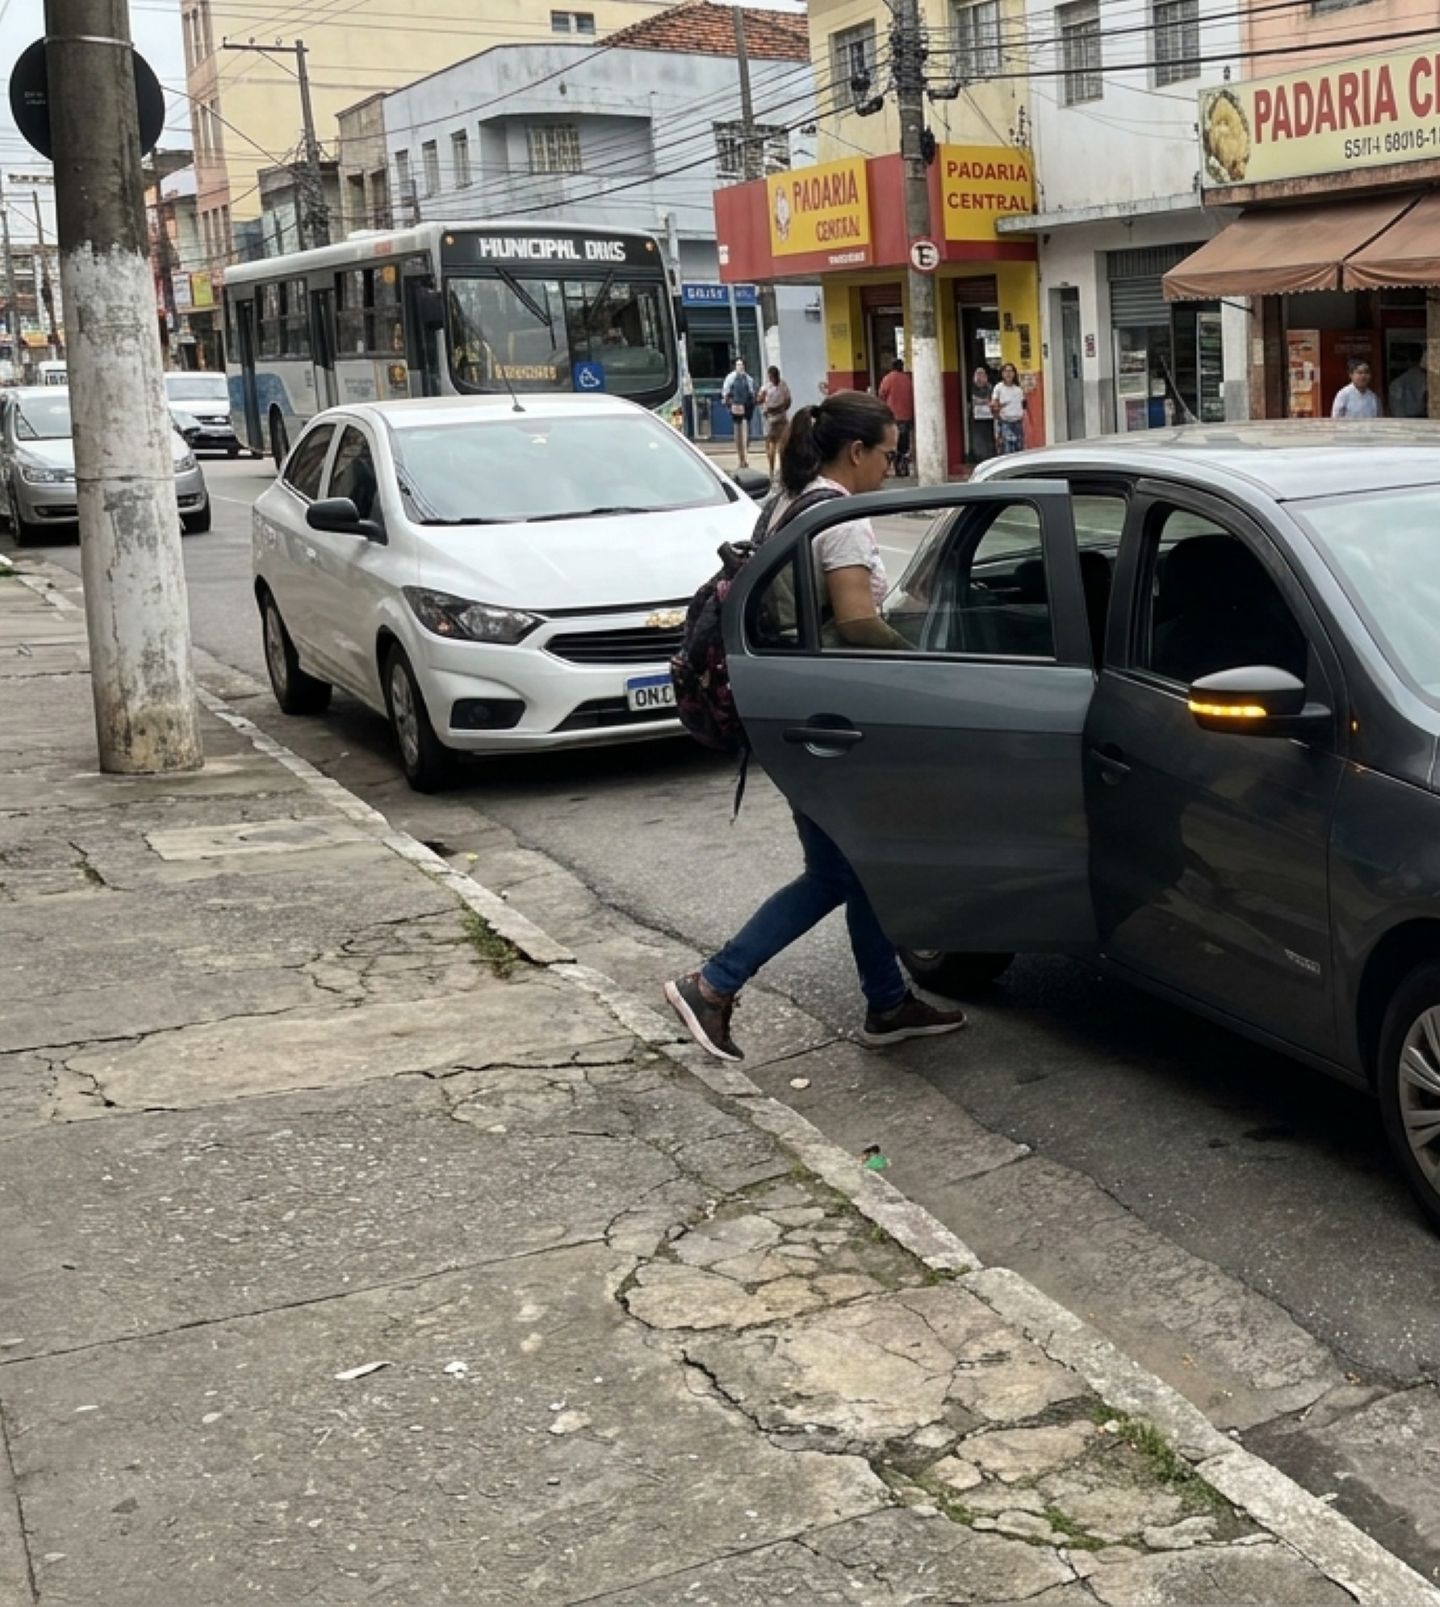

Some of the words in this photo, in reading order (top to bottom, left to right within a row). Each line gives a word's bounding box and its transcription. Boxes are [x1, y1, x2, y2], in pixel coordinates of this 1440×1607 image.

[1254, 64, 1398, 144] PADARIA
[947, 161, 1028, 182] PADARIA
[947, 192, 1030, 211] CENTRAL
[916, 245, 933, 266] E
